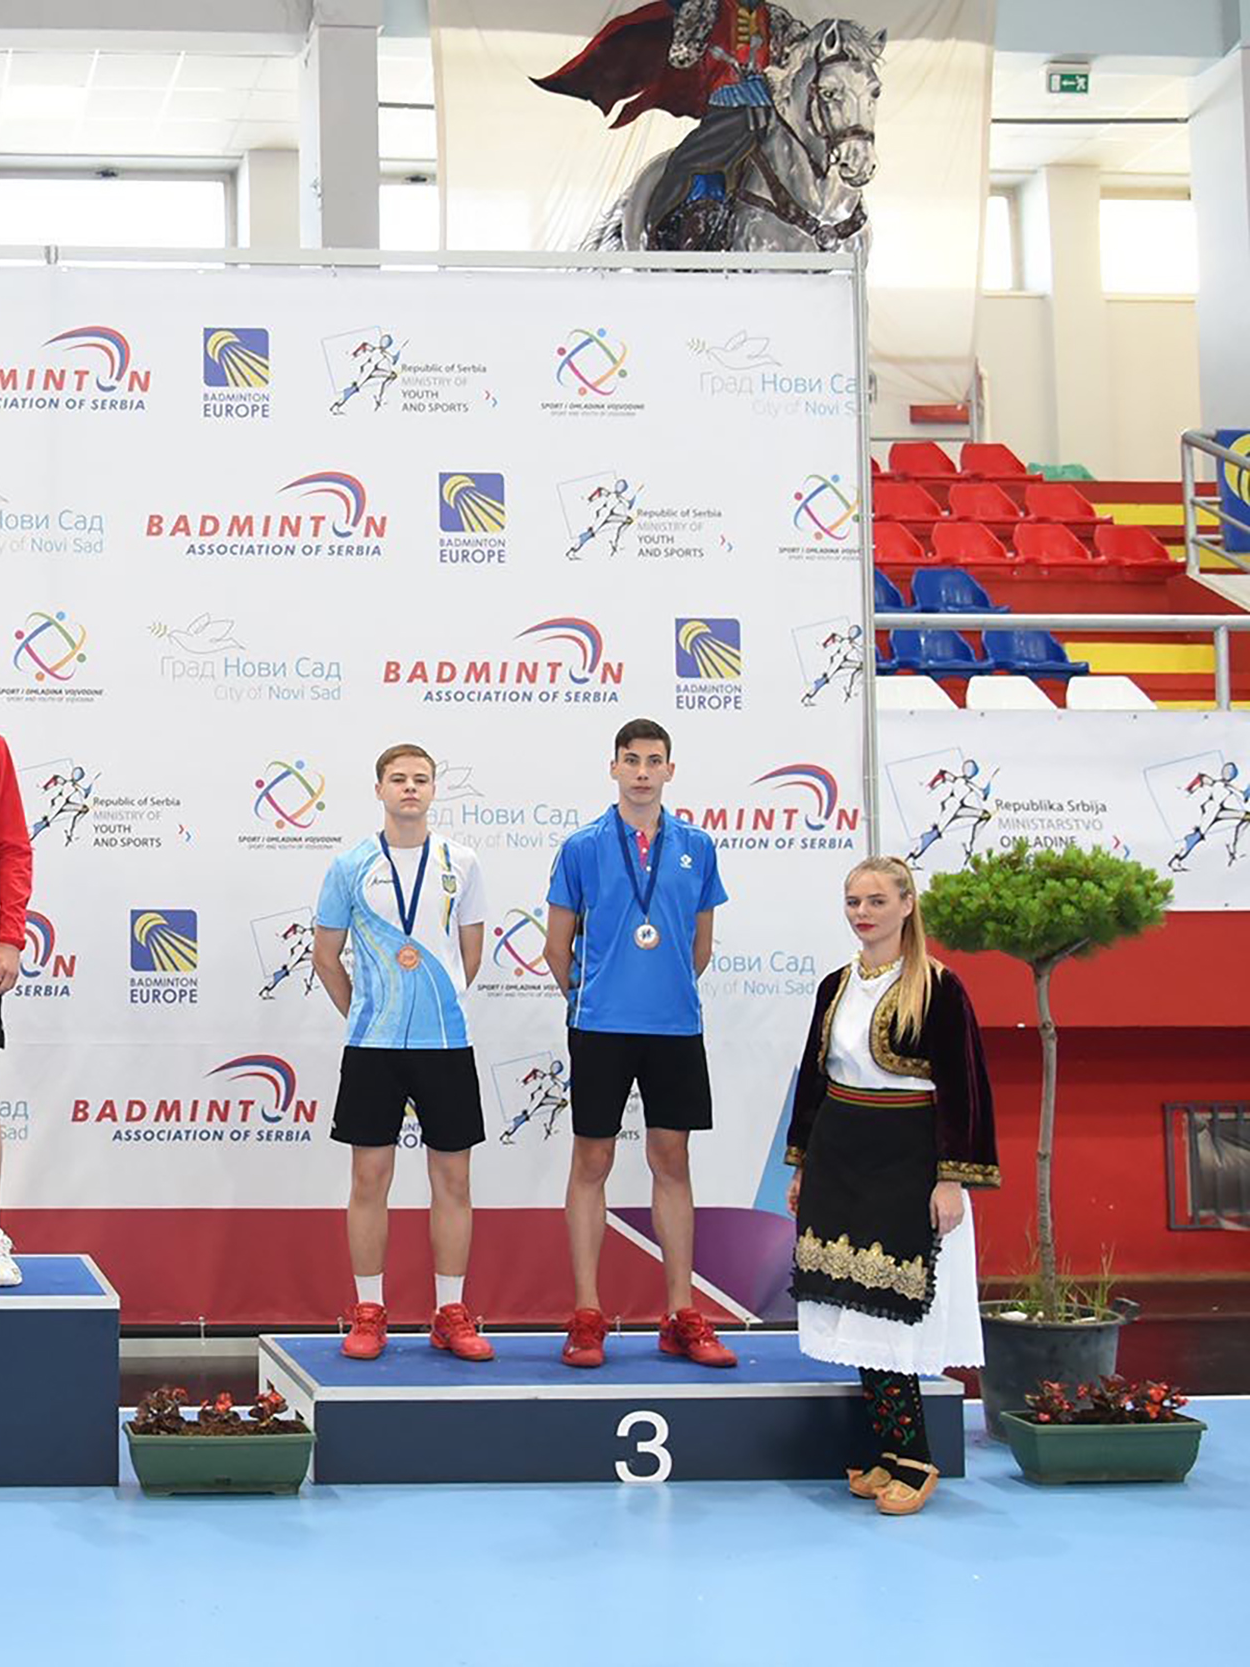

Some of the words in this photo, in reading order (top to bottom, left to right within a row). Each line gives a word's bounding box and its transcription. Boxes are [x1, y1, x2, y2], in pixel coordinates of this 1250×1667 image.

[402, 364, 443, 374] Republic
[445, 364, 455, 373] of
[457, 364, 486, 373] Serbia
[402, 377, 451, 385] MINISTRY
[761, 373, 822, 393] Нови
[204, 393, 269, 401] BADMINTON
[402, 390, 439, 399] YOUTH
[65, 399, 87, 410] OF
[91, 399, 146, 411] SERBIA
[203, 404, 269, 418] EUROPE
[402, 403, 425, 412] AND
[428, 403, 469, 412] SPORTS
[805, 401, 839, 415] Novi
[637, 509, 676, 519] Republic
[680, 509, 691, 517] of
[693, 509, 722, 518] Serbia
[59, 510, 104, 534] Сад
[637, 522, 686, 531] MINISTRY
[31, 538, 67, 552] Novi
[72, 538, 103, 552] Sad
[439, 539, 506, 547] BADMINTON
[638, 536, 674, 544] YOUTH
[186, 544, 295, 556] ASSOCIATION
[302, 545, 322, 556] OF
[328, 545, 382, 556] SERBIA
[638, 548, 661, 557] AND
[664, 548, 704, 558] SPORTS
[439, 550, 506, 563] EUROPE
[224, 657, 286, 677] Нови
[296, 657, 341, 681] Сад
[269, 686, 304, 700] Novi
[311, 685, 340, 700] Sad
[676, 685, 742, 693] BADMINTON
[423, 691, 532, 702] ASSOCIATION
[538, 691, 559, 702] OF
[564, 691, 619, 702] SERBIA
[676, 696, 742, 709] EUROPE
[93, 798, 134, 808] Republic
[138, 798, 147, 806] of
[150, 798, 180, 807] Serbia
[995, 800, 1064, 813] Republika
[1067, 800, 1107, 814] Srbija
[93, 811, 147, 820] MINISTRY
[462, 805, 524, 825] Нови
[533, 805, 578, 826] Сад
[93, 824, 131, 834] YOUTH
[998, 818, 1103, 831] MINISTARSTVO
[93, 838, 116, 847] AND
[121, 838, 162, 847] SPORTS
[506, 834, 543, 847] Novi
[777, 838, 796, 849] OF
[801, 838, 853, 849] SERBIA
[770, 952, 814, 974] Сад
[130, 978, 198, 986] BADMINTON
[15, 985, 70, 996] SERBIA
[744, 982, 778, 996] Novi
[785, 982, 815, 996] Sad
[130, 990, 198, 1004] EUROPE
[112, 1130, 224, 1141] ASSOCIATION
[230, 1130, 251, 1141] OF
[256, 1130, 311, 1142] SERBIA
[614, 1409, 672, 1482] 3
